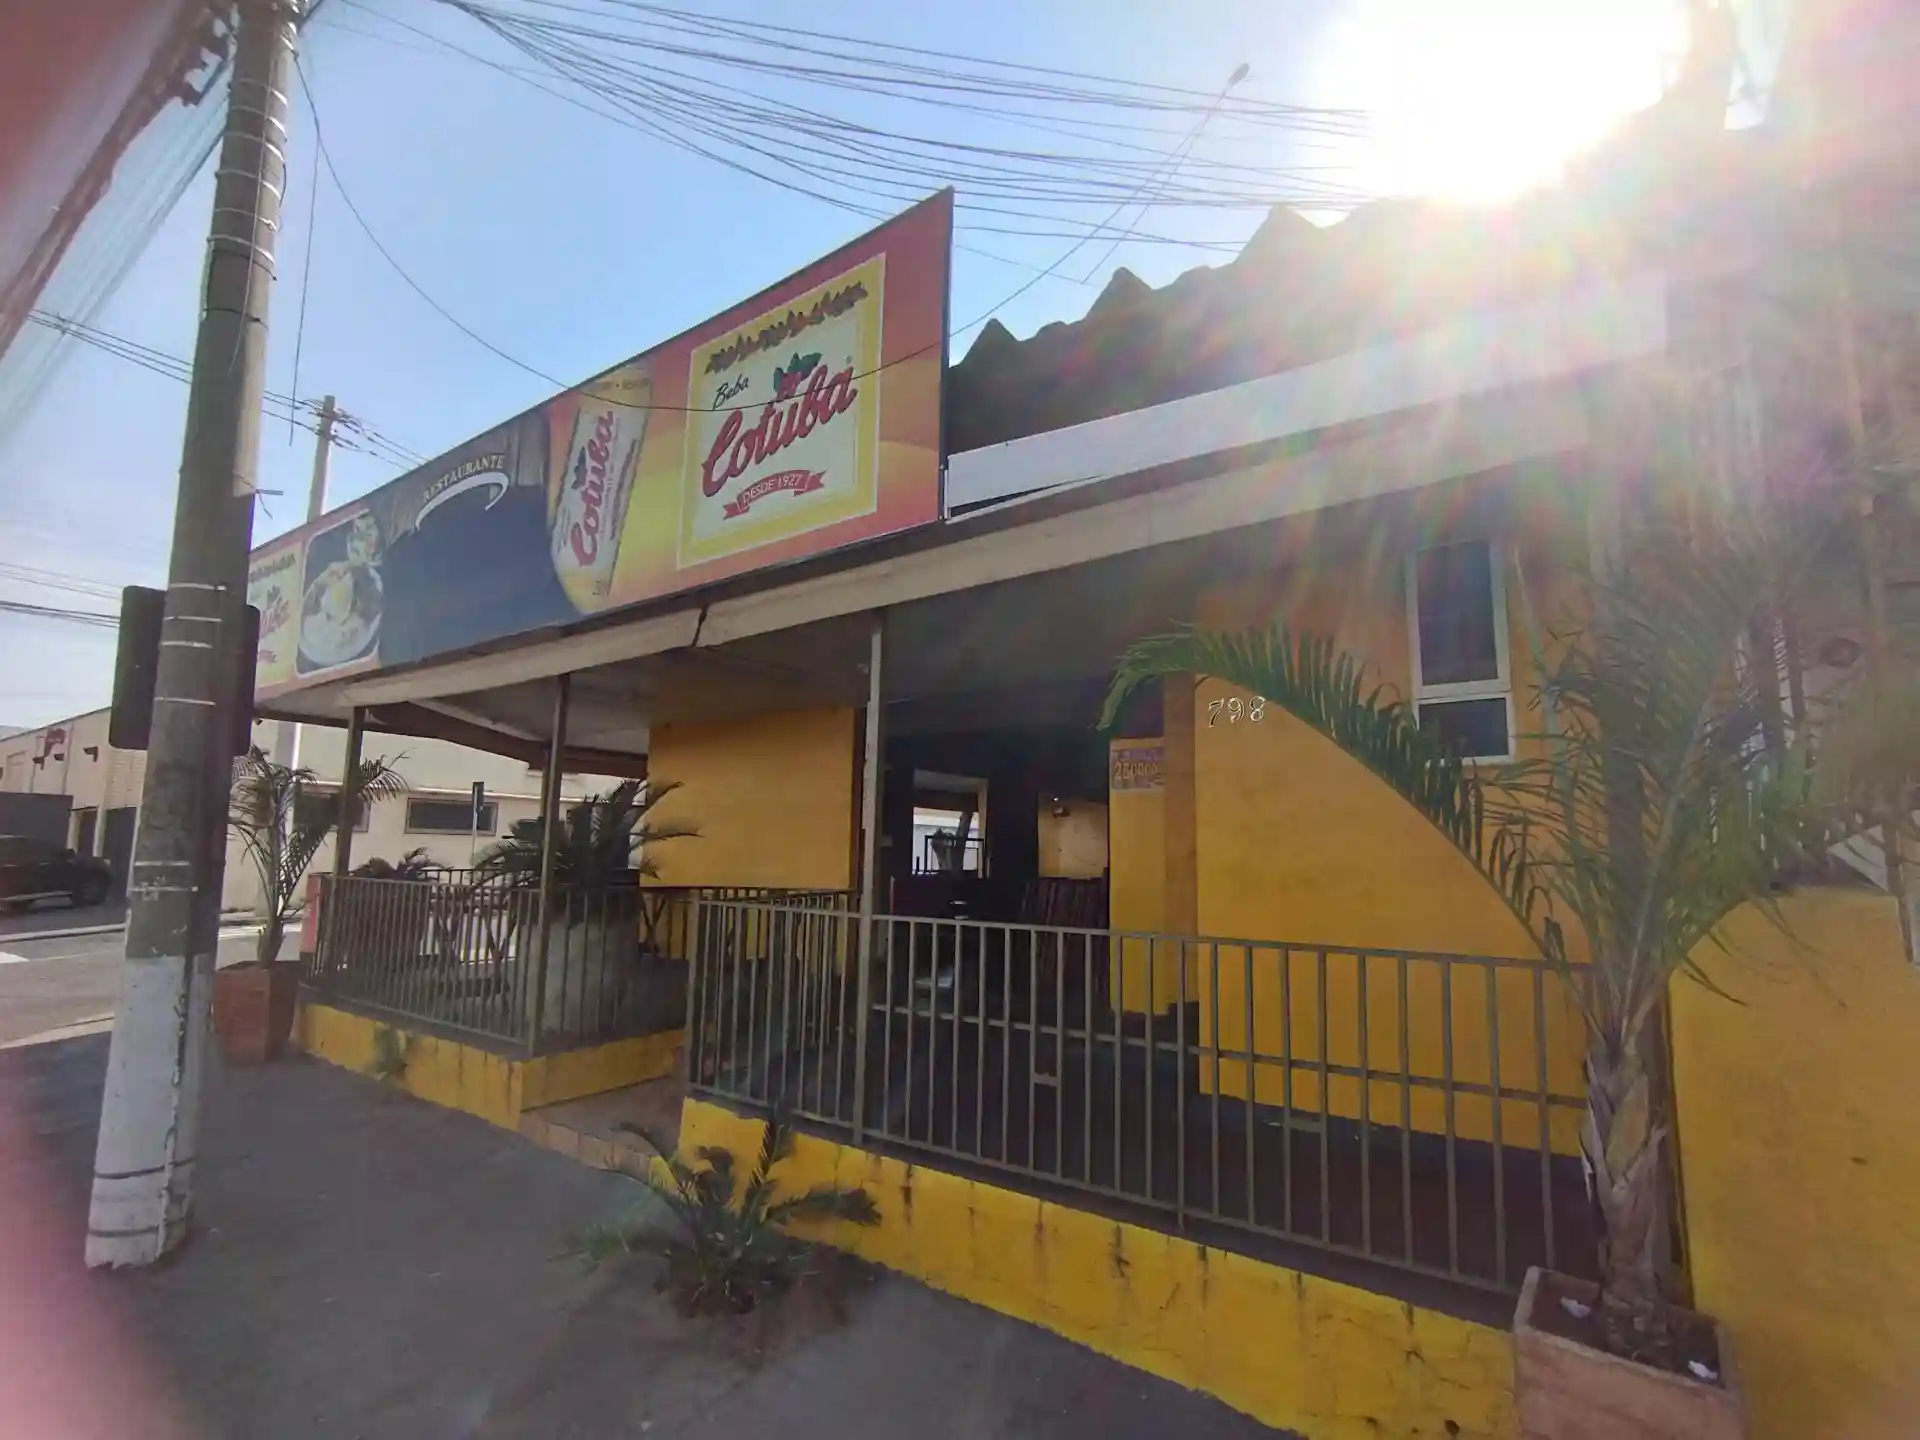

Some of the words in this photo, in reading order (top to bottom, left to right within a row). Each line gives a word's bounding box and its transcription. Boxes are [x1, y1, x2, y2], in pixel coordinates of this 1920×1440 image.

[712, 376, 750, 411] Beba
[702, 364, 858, 498] Cotuba
[423, 454, 505, 503] RESTAURANTE
[570, 410, 614, 567] Cotuba
[742, 479, 776, 504] DESDE
[777, 473, 803, 490] 1927
[1208, 695, 1266, 728] 798
